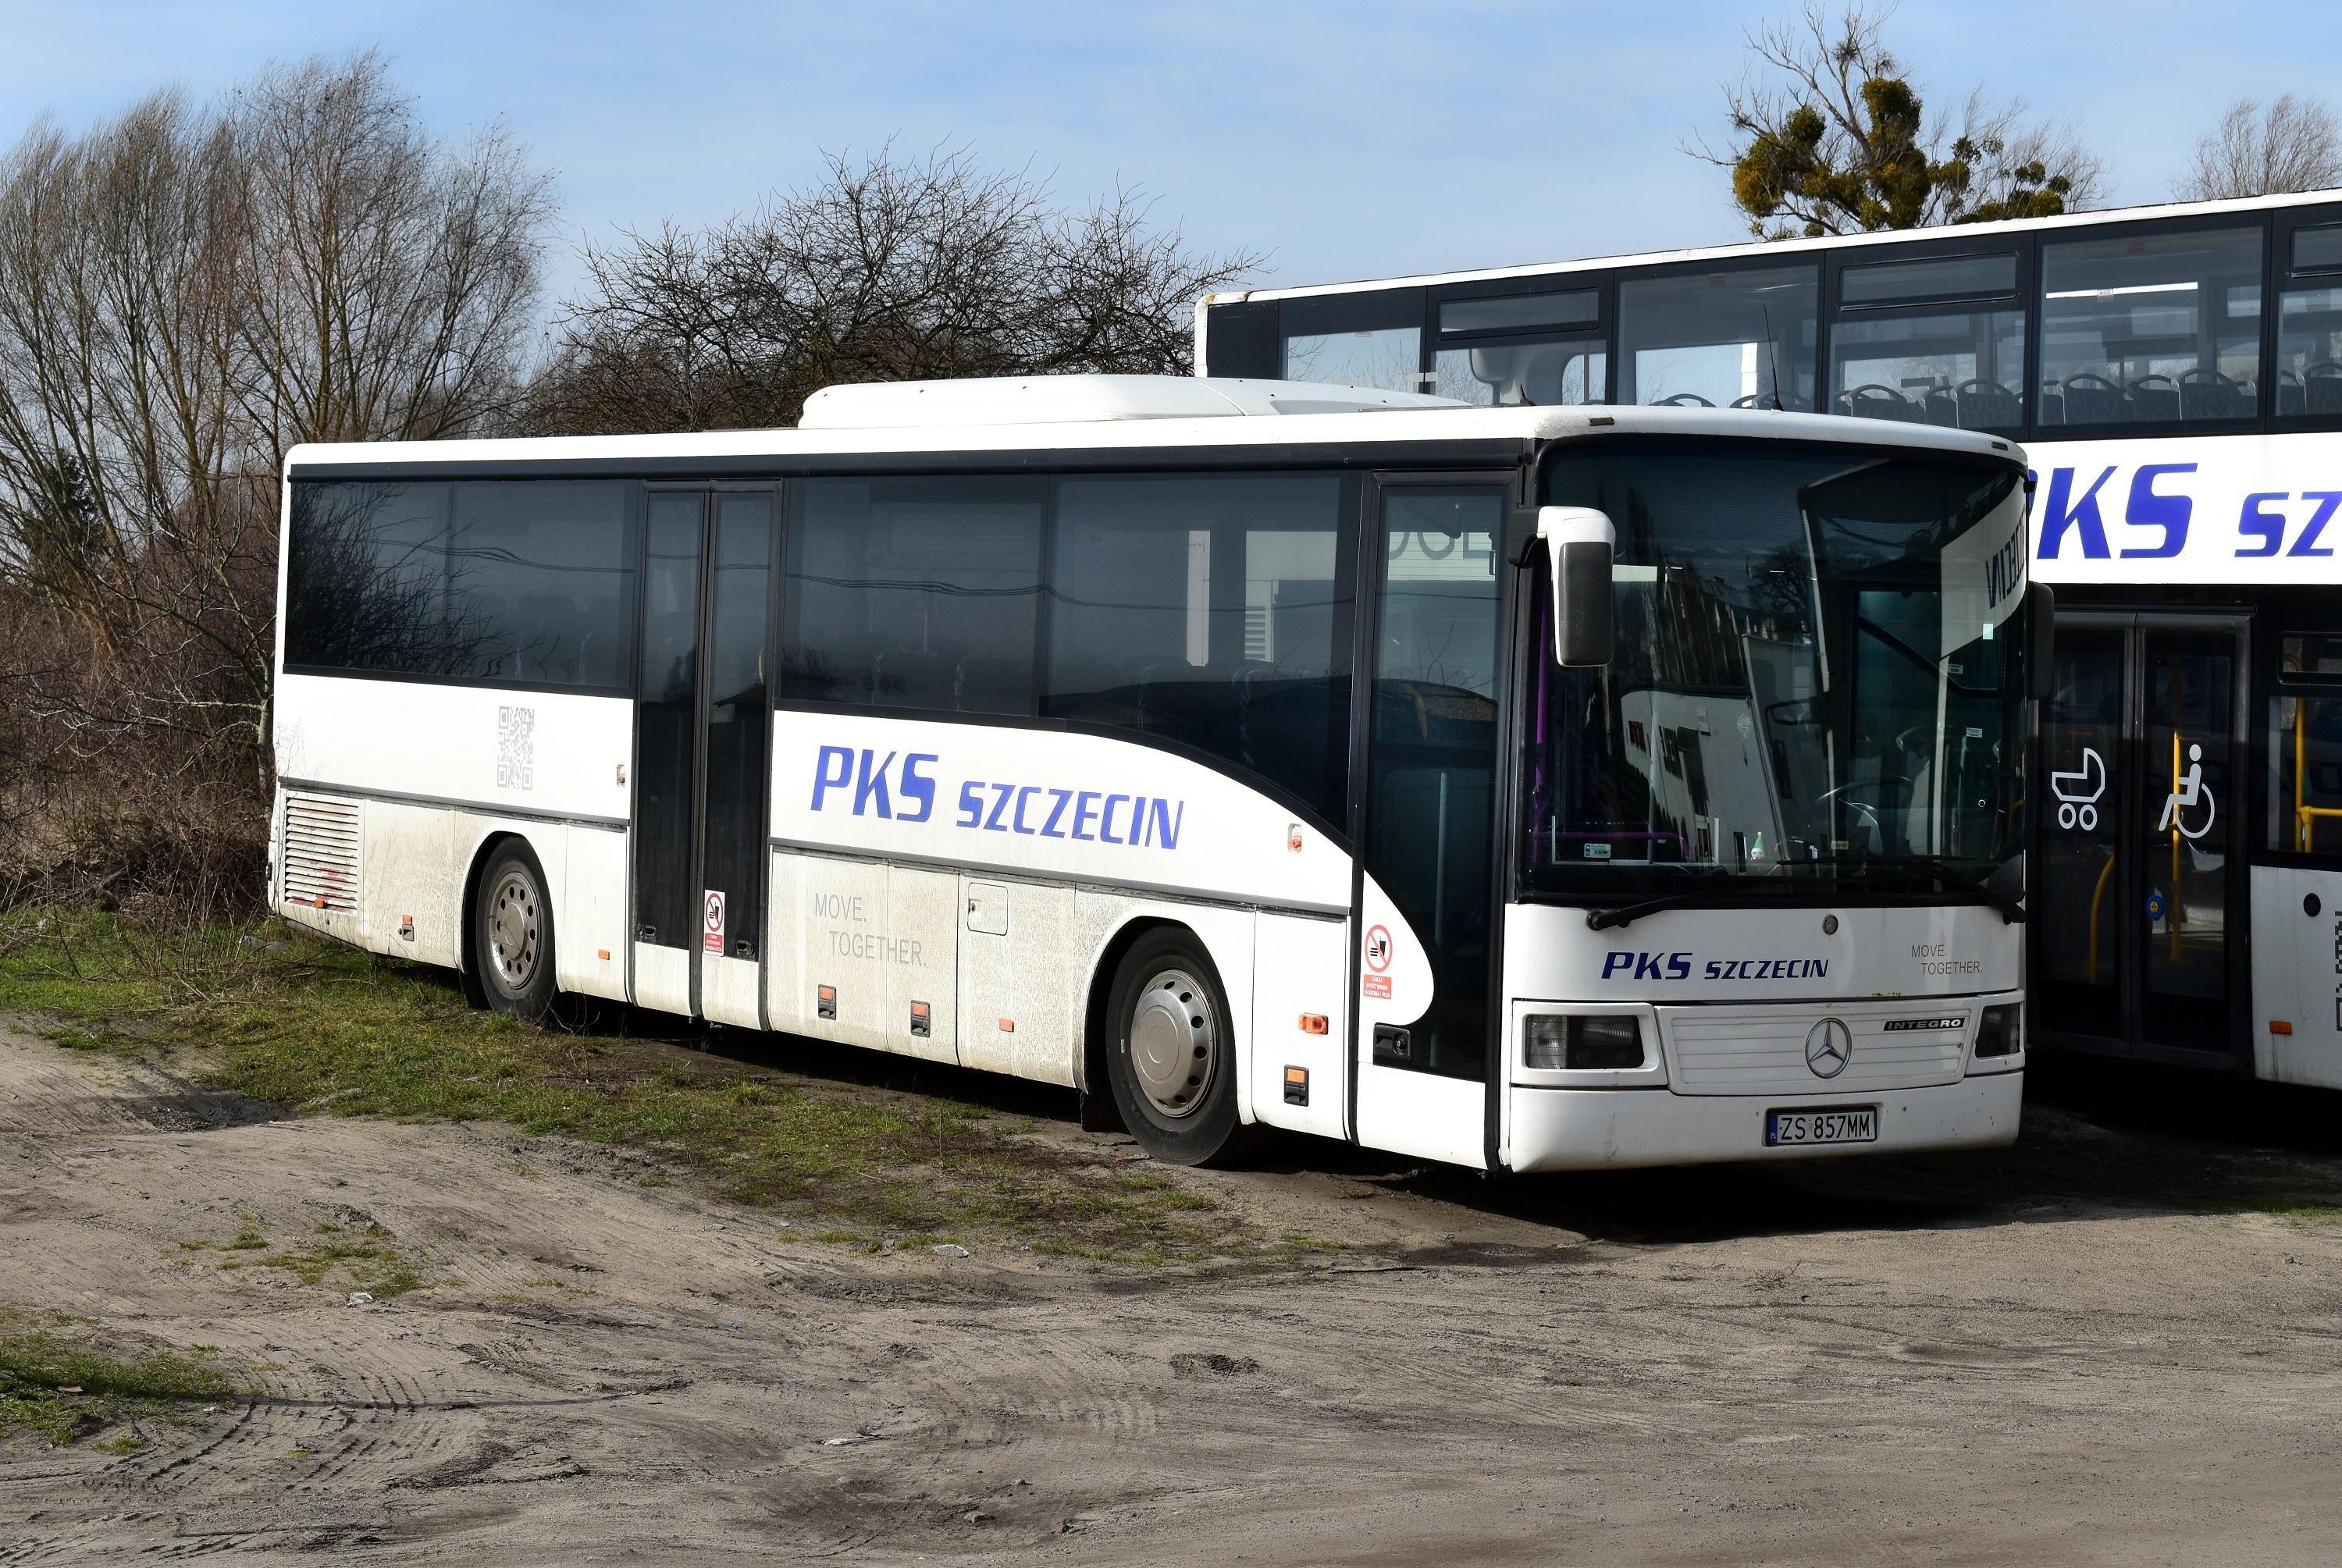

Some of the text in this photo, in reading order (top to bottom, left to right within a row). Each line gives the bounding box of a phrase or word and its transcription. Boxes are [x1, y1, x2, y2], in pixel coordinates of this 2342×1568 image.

[2027, 463, 2198, 560] KS
[810, 745, 1183, 850] PKS SZCZECIN
[815, 892, 867, 923] MOVE.
[829, 930, 927, 966] TOGETHER.
[1911, 944, 1948, 958] MOVE.
[1601, 951, 1829, 980] PKS SZCZECIN
[1921, 961, 1983, 975] TOGETHER.
[1887, 1019, 1962, 1030] INTEGRO
[1781, 1117, 1806, 1140] ZS
[1813, 1115, 1870, 1140] 857MM
